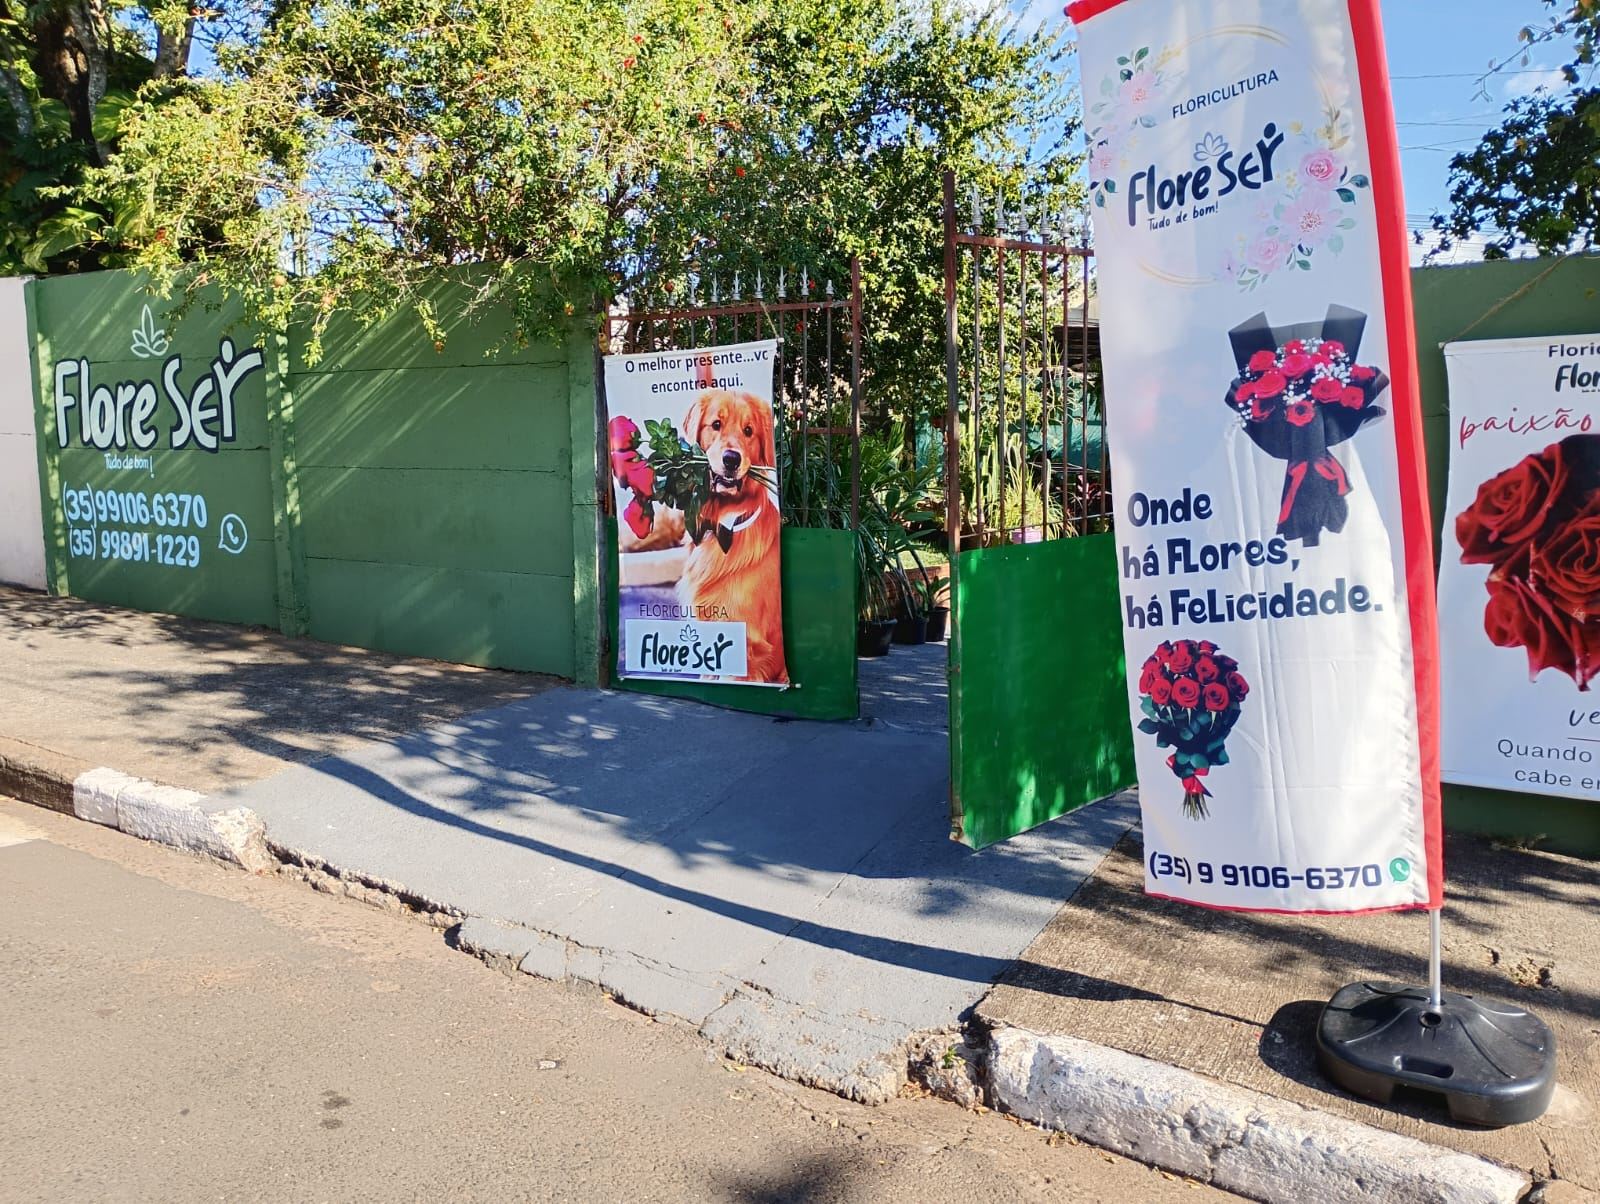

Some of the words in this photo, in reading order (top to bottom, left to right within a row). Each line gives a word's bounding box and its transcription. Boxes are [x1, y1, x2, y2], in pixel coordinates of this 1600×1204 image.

[1171, 69, 1280, 119] FLORICULTURA
[1147, 216, 1171, 231] Tudo
[1176, 211, 1188, 223] de
[1193, 201, 1219, 219] bom!
[625, 361, 635, 373] O
[638, 357, 681, 372] melhor
[651, 378, 707, 394] encontra
[711, 373, 744, 392] aqui.
[1459, 408, 1592, 450] paixão
[104, 453, 121, 470] Tudo
[122, 454, 134, 470] de
[1127, 487, 1214, 528] Onde
[69, 524, 97, 560] (35)
[101, 530, 200, 568] 99891-1229
[1122, 544, 1160, 579] há
[639, 604, 729, 619] FLORICULTURA
[1125, 592, 1164, 629] há
[1497, 739, 1592, 763] Quando
[1514, 769, 1572, 787] cabe
[1149, 851, 1192, 885] (35)
[1197, 862, 1213, 884] 9
[1222, 863, 1383, 890] 9106-6370
